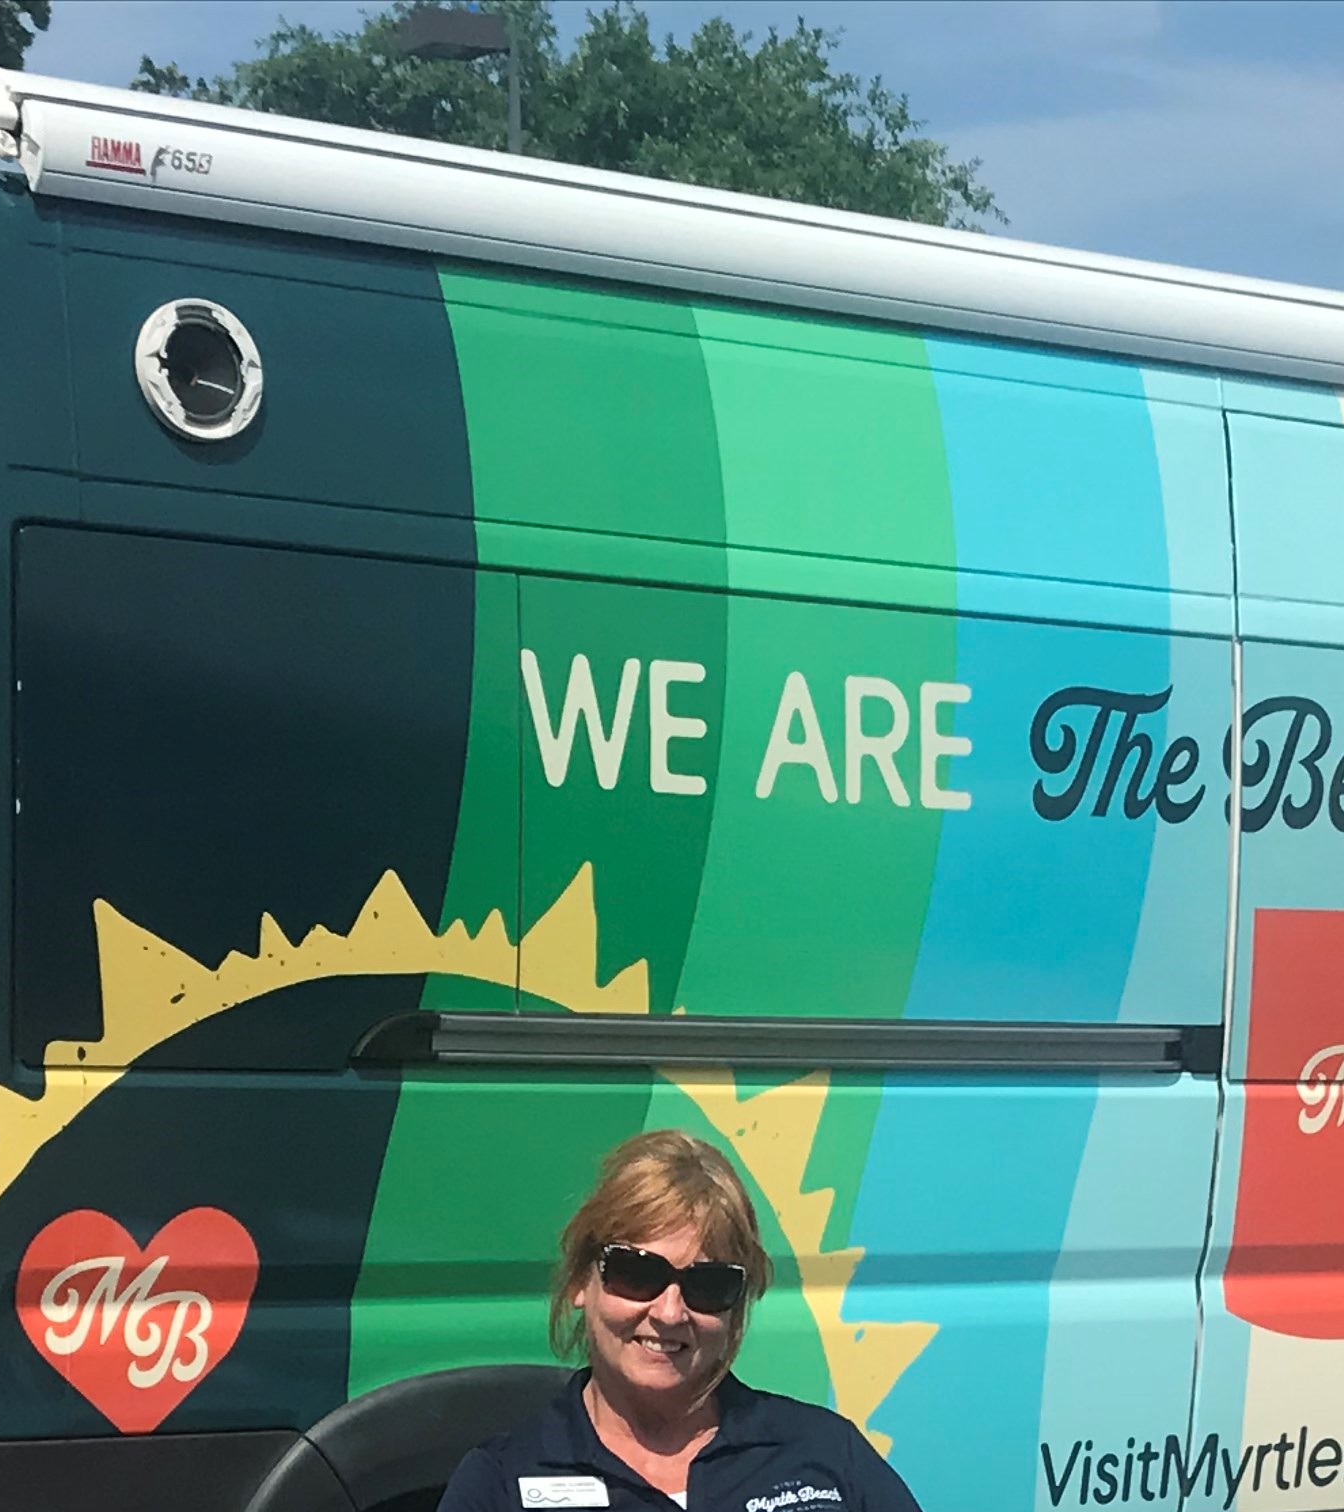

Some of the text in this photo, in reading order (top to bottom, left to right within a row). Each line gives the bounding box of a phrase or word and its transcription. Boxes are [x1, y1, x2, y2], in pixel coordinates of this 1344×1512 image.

[90, 135, 143, 168] FIAMMA
[520, 648, 708, 796] WE
[756, 671, 973, 811] ARE
[1029, 684, 1206, 824] The
[39, 1255, 213, 1389] MB
